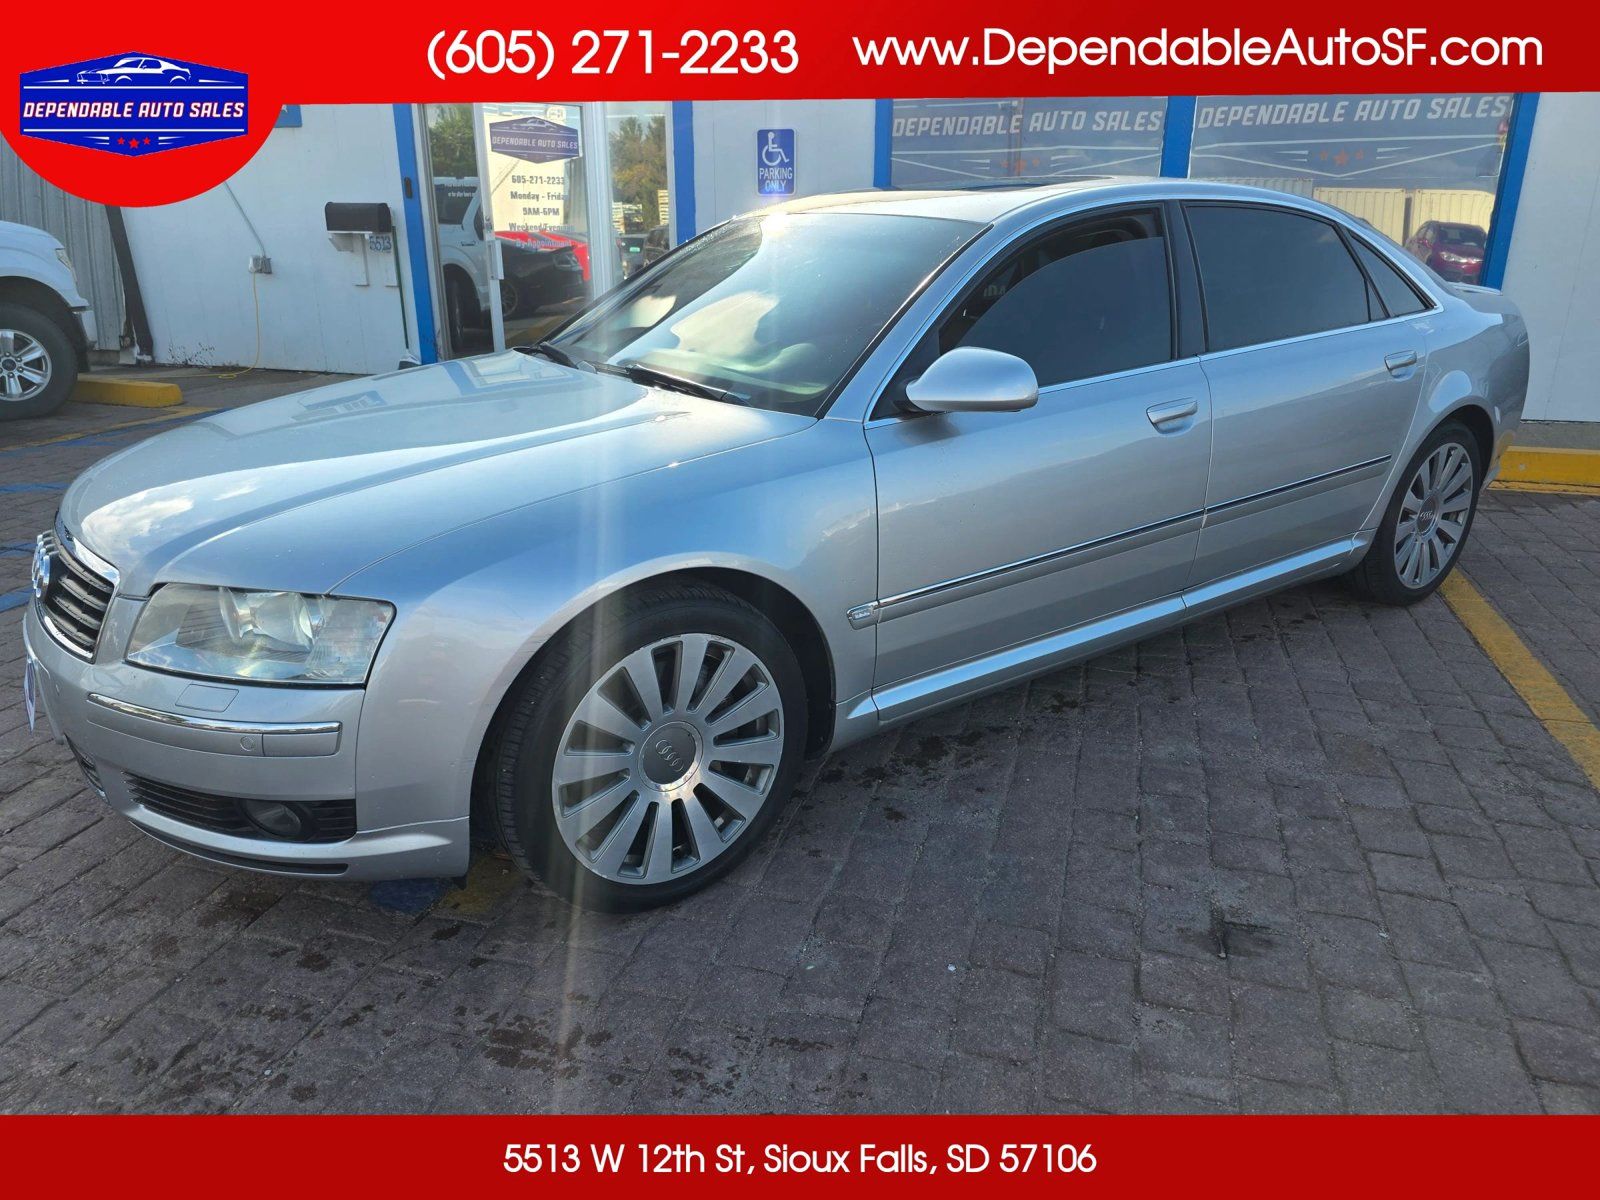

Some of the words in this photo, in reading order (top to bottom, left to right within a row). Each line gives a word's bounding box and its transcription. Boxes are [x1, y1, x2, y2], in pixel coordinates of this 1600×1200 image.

[1198, 101, 1349, 128] DEPENDABLE
[1354, 98, 1420, 121] AUTO
[1427, 94, 1510, 119] SALES
[892, 114, 1022, 138] DEPENDABLE
[1029, 110, 1086, 133] AUTO
[1092, 109, 1163, 132] SALES
[491, 136, 536, 147] DEPENDABLE
[537, 138, 556, 148] AUTO
[556, 140, 578, 150] SALES
[759, 167, 793, 180] PARKING
[764, 179, 787, 192] ONLY
[510, 190, 539, 202] Monday
